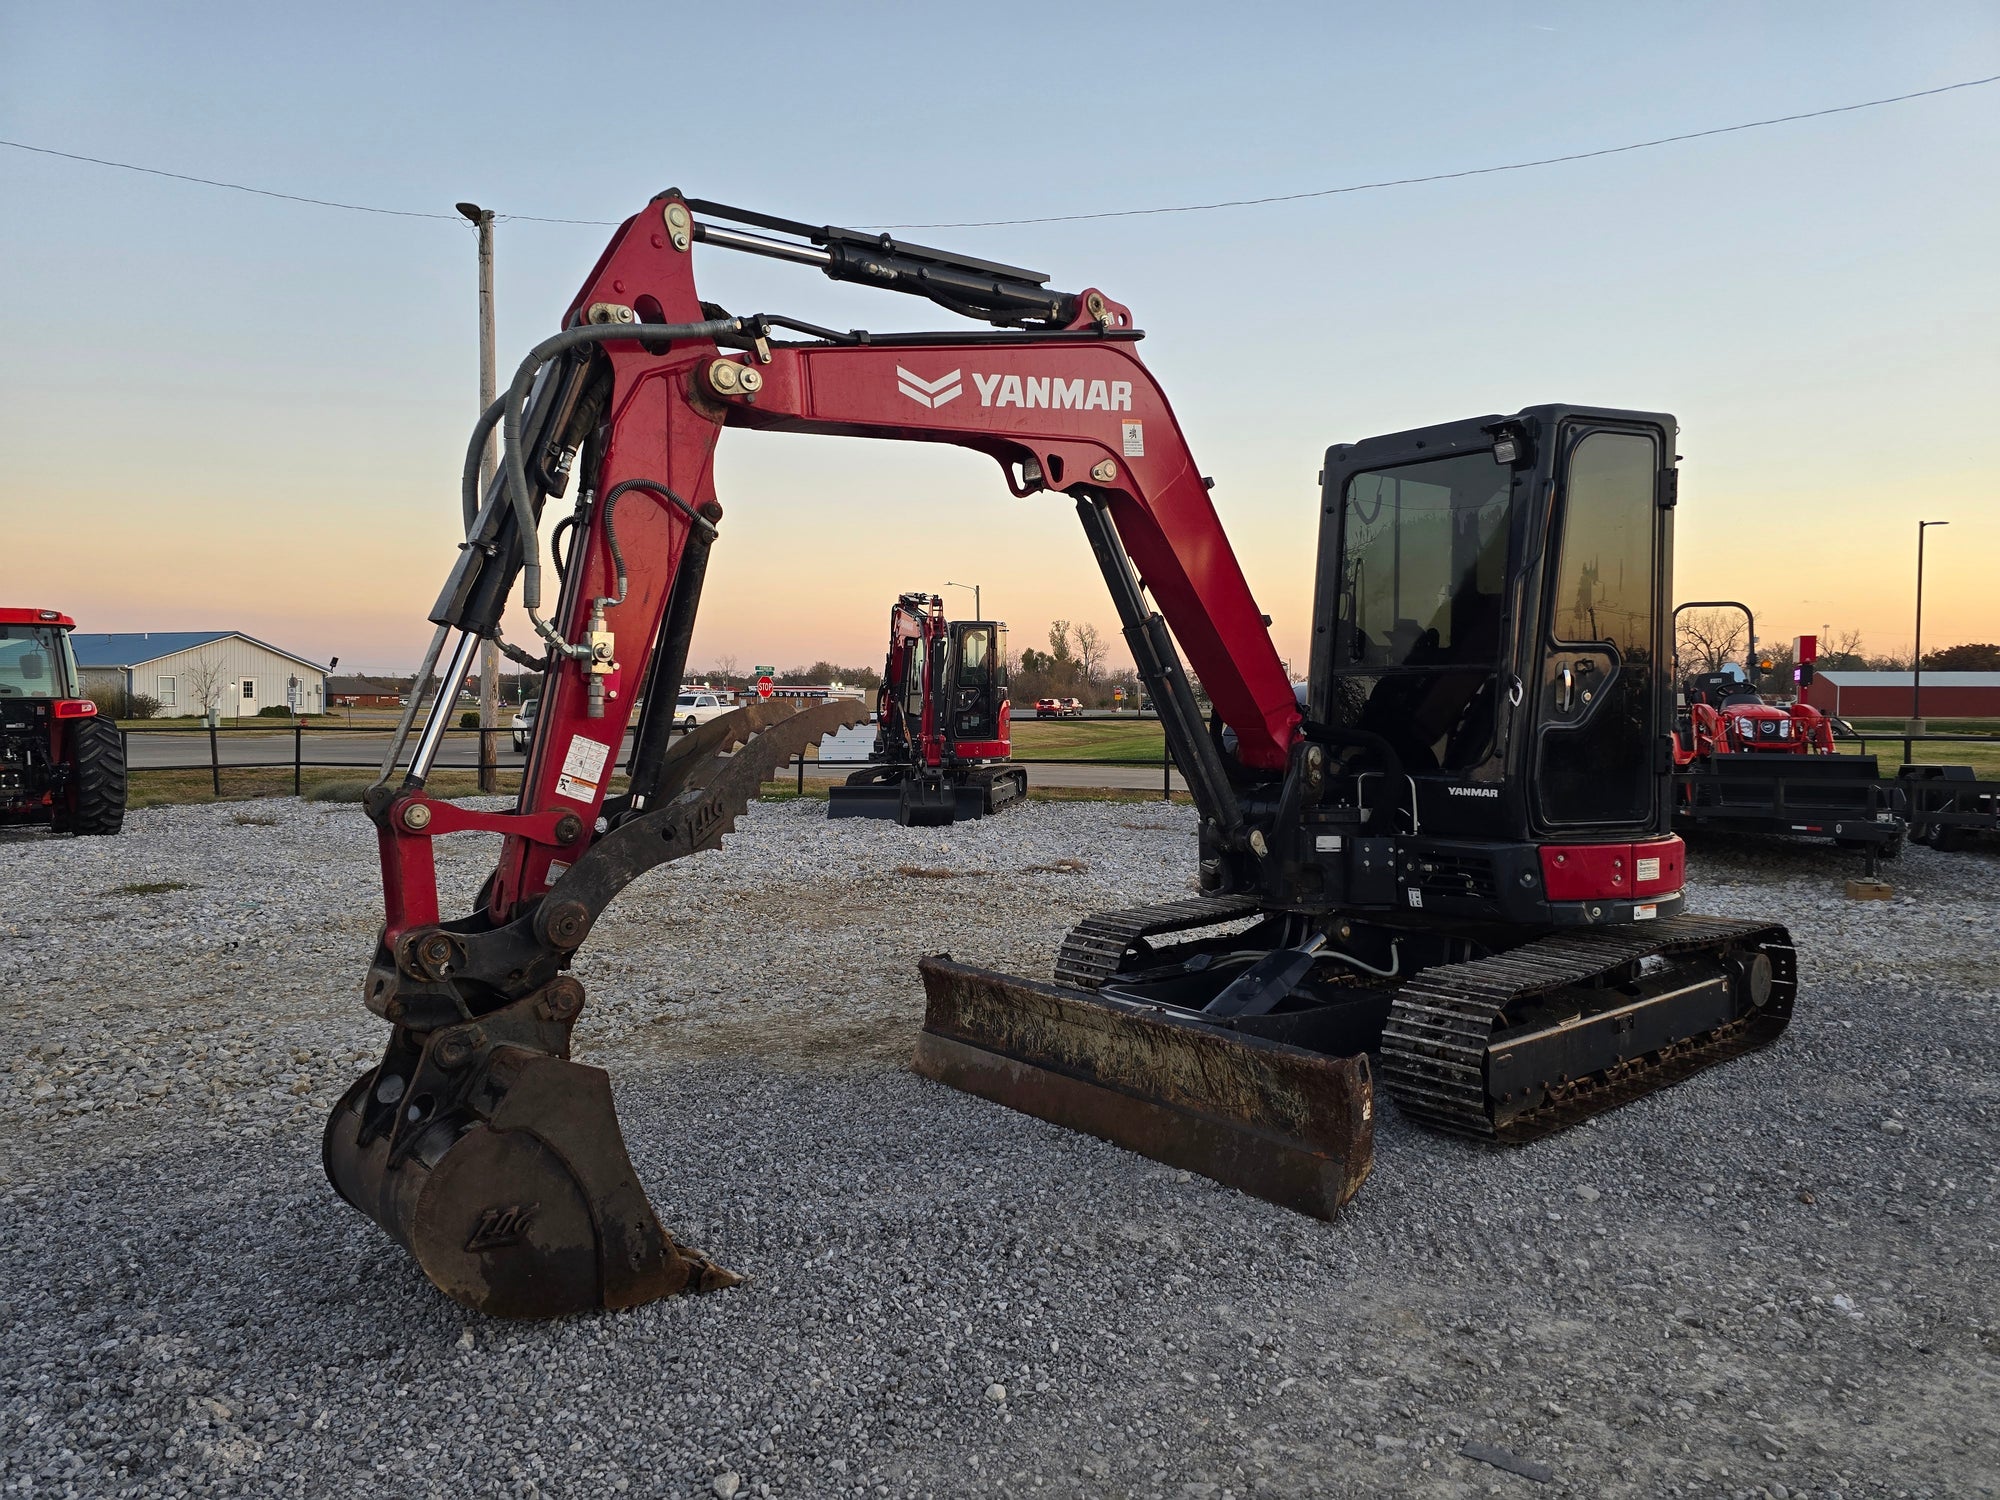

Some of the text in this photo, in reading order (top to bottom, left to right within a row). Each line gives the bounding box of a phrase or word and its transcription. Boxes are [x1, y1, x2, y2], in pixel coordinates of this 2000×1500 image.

[971, 373, 1132, 411] YANMAR
[758, 682, 773, 692] STOP
[1448, 787, 1498, 797] YANMAR
